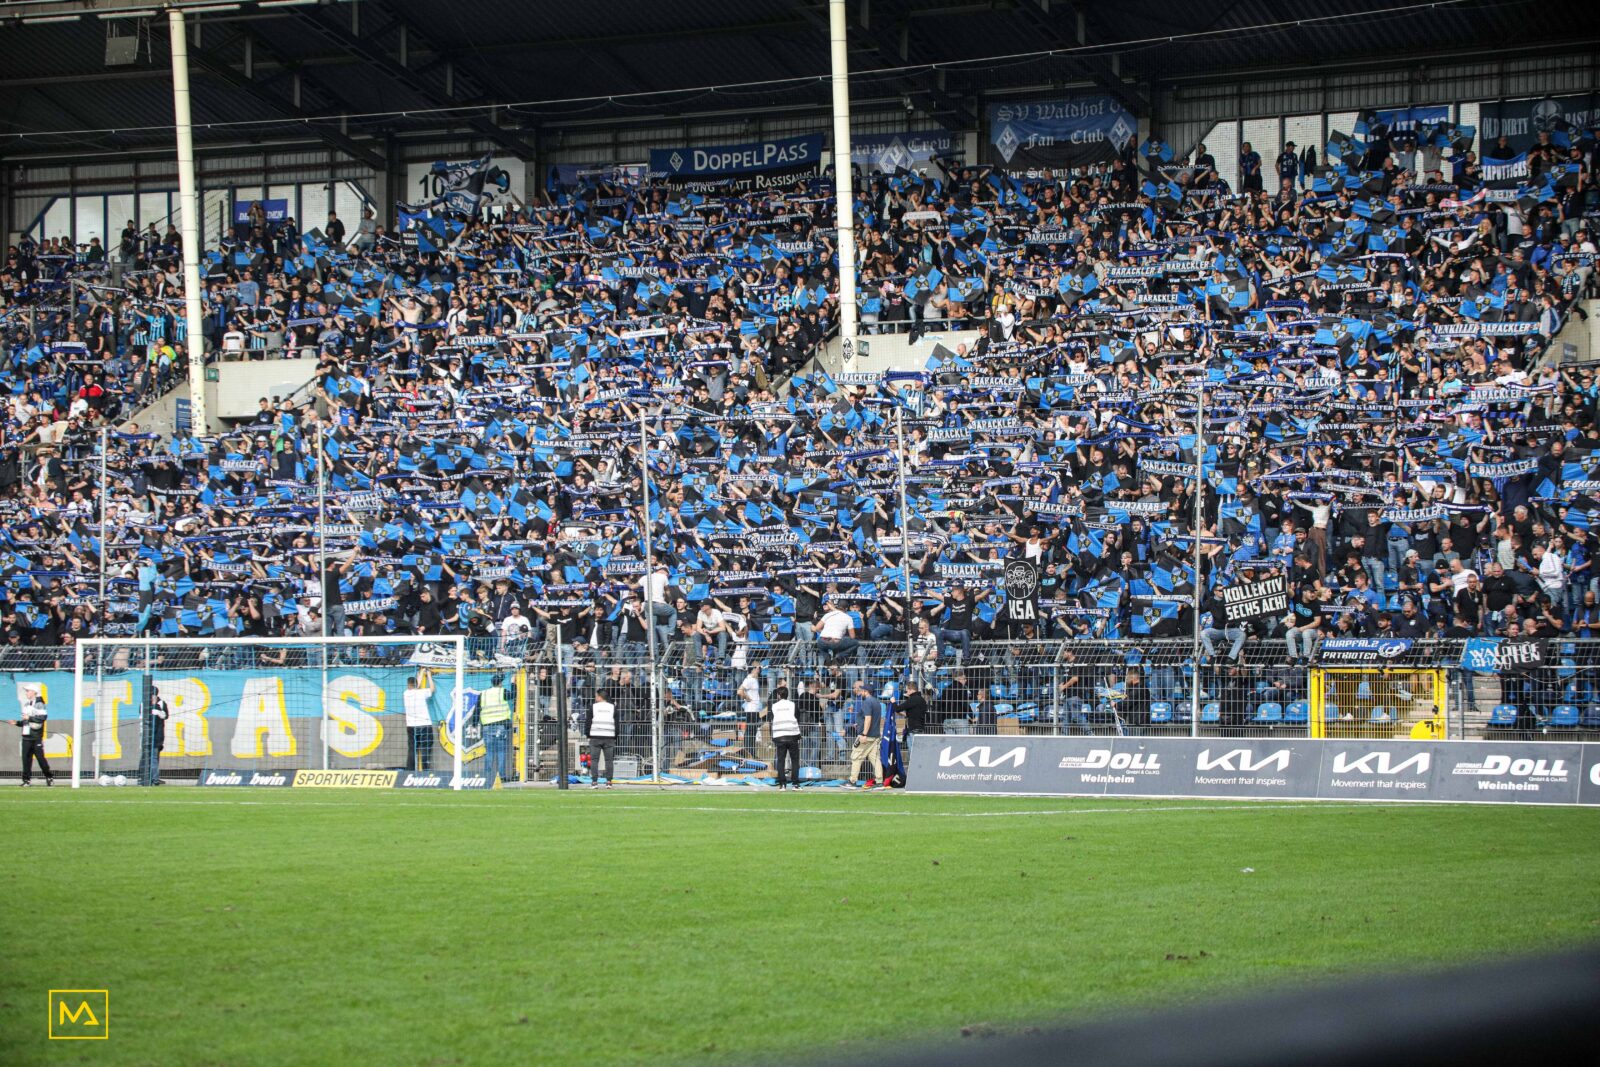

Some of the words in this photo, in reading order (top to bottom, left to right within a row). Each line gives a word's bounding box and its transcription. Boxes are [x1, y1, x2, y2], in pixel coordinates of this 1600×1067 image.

[1482, 118, 1499, 139] OLD
[1502, 117, 1528, 137] DIRTY
[1024, 133, 1055, 151] Fan
[1070, 128, 1104, 145] Club
[1111, 267, 1155, 277] BARACKLER
[1166, 261, 1209, 271] BARACKLER
[1139, 294, 1178, 303] BARACKLE
[1481, 323, 1530, 333] BARACKLER
[835, 373, 876, 383] BARACKLER
[975, 376, 1017, 386] BARACKLER
[1305, 377, 1340, 387] ARACKLE
[1471, 389, 1522, 400] BARACKLER
[973, 417, 1016, 430] BARACKLER
[929, 427, 971, 439] BARACKLE
[1479, 462, 1527, 476] BARACKLER
[1028, 501, 1077, 514] BARACKLER
[1389, 507, 1441, 521] BARACKLER
[324, 524, 363, 534] BARACKLE
[603, 562, 644, 573] ARACKLER
[1223, 577, 1283, 603] KOLLEKTIV
[1009, 599, 1036, 620] KSA
[1225, 603, 1262, 621] SECHS
[1262, 594, 1287, 613] ACHT
[1325, 640, 1379, 648] KURPFALZ
[1322, 651, 1378, 660] PATRIOTEN
[938, 745, 1027, 769] KIA
[1086, 749, 1161, 769] DOLL
[1196, 749, 1291, 772] KIA
[1332, 751, 1431, 775] KIA
[1482, 755, 1569, 776] DOLL
[205, 772, 242, 786] bwin
[249, 772, 287, 786] bwin
[296, 772, 394, 786] SPORTWETTEN
[403, 772, 442, 786] bwin
[937, 771, 976, 781] Movement
[978, 773, 992, 781] that
[993, 774, 1022, 782] inspires
[1080, 773, 1135, 783] Weinheim
[1195, 776, 1236, 785] Movement
[1239, 776, 1255, 785] that
[1256, 777, 1287, 787] inspires
[1331, 779, 1374, 788] Movement
[1377, 779, 1394, 789] that
[1395, 779, 1427, 790] inspires
[1478, 780, 1540, 791] Weinheim
